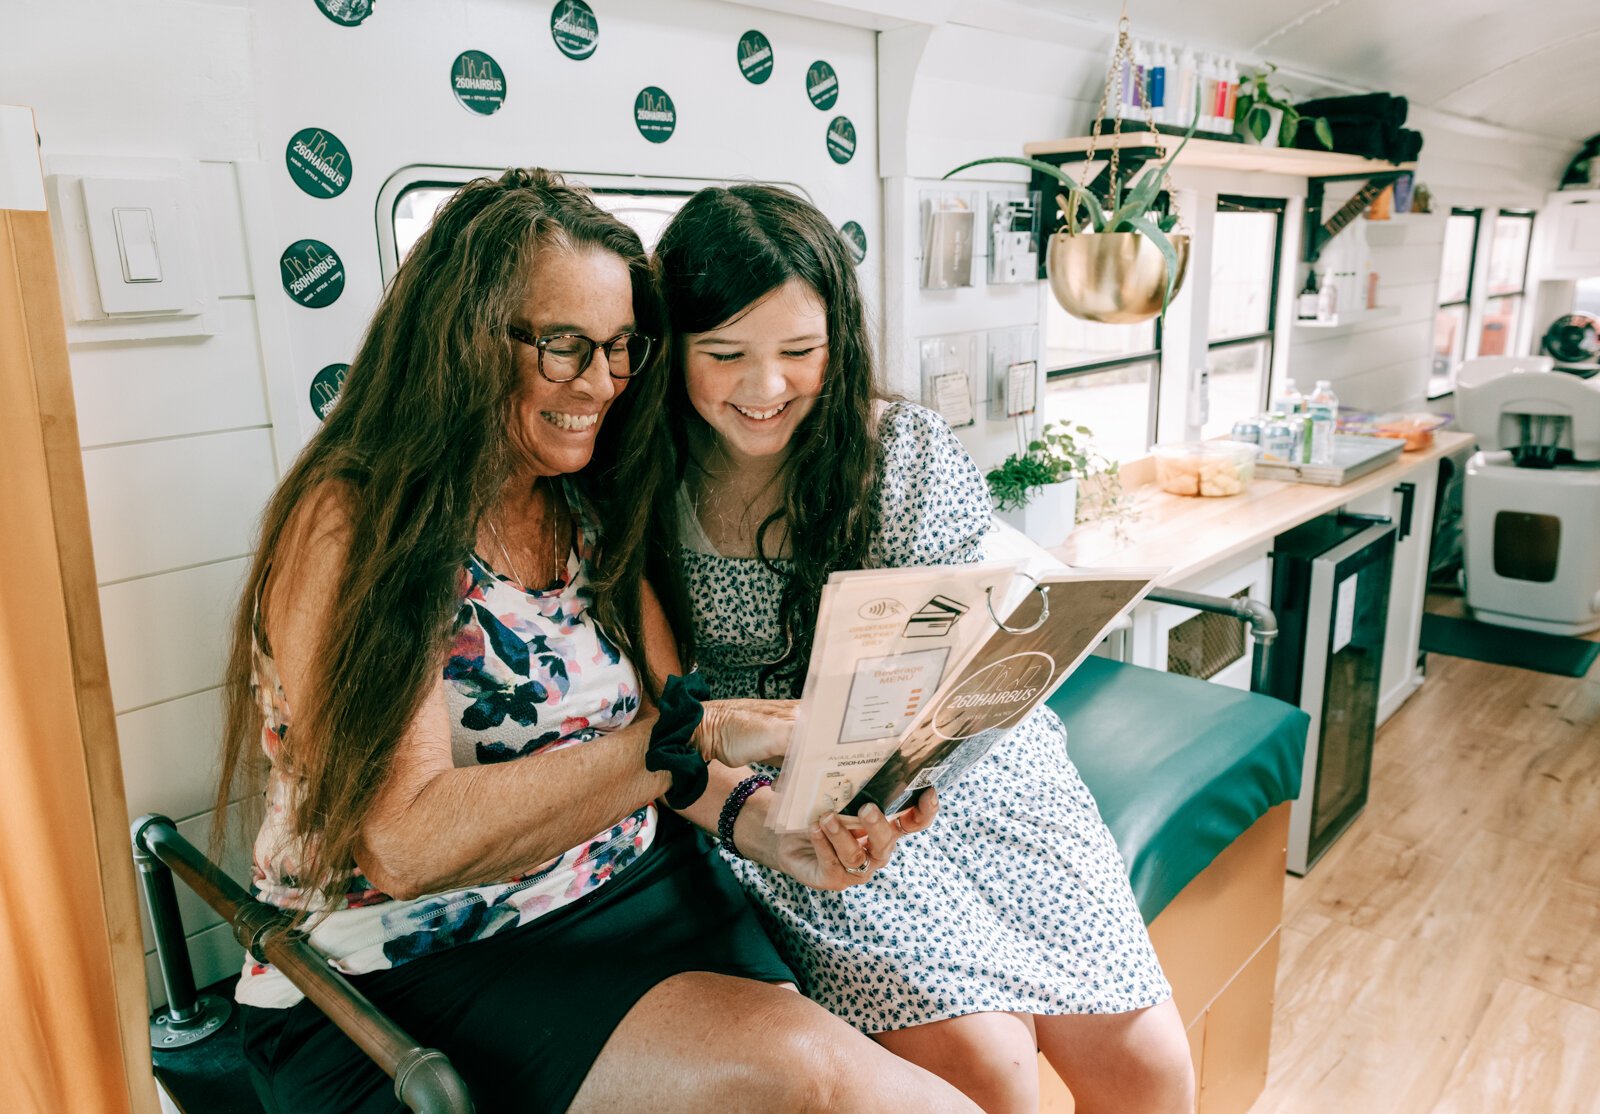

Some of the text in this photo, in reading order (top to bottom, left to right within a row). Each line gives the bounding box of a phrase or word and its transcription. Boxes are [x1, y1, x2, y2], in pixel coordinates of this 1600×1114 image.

[455, 77, 502, 91] 260HAIRBUS
[293, 140, 345, 187] 260HAIRBUS
[290, 255, 337, 296] 260HAIRBUS
[947, 688, 1037, 709] 260HAIRBUS
